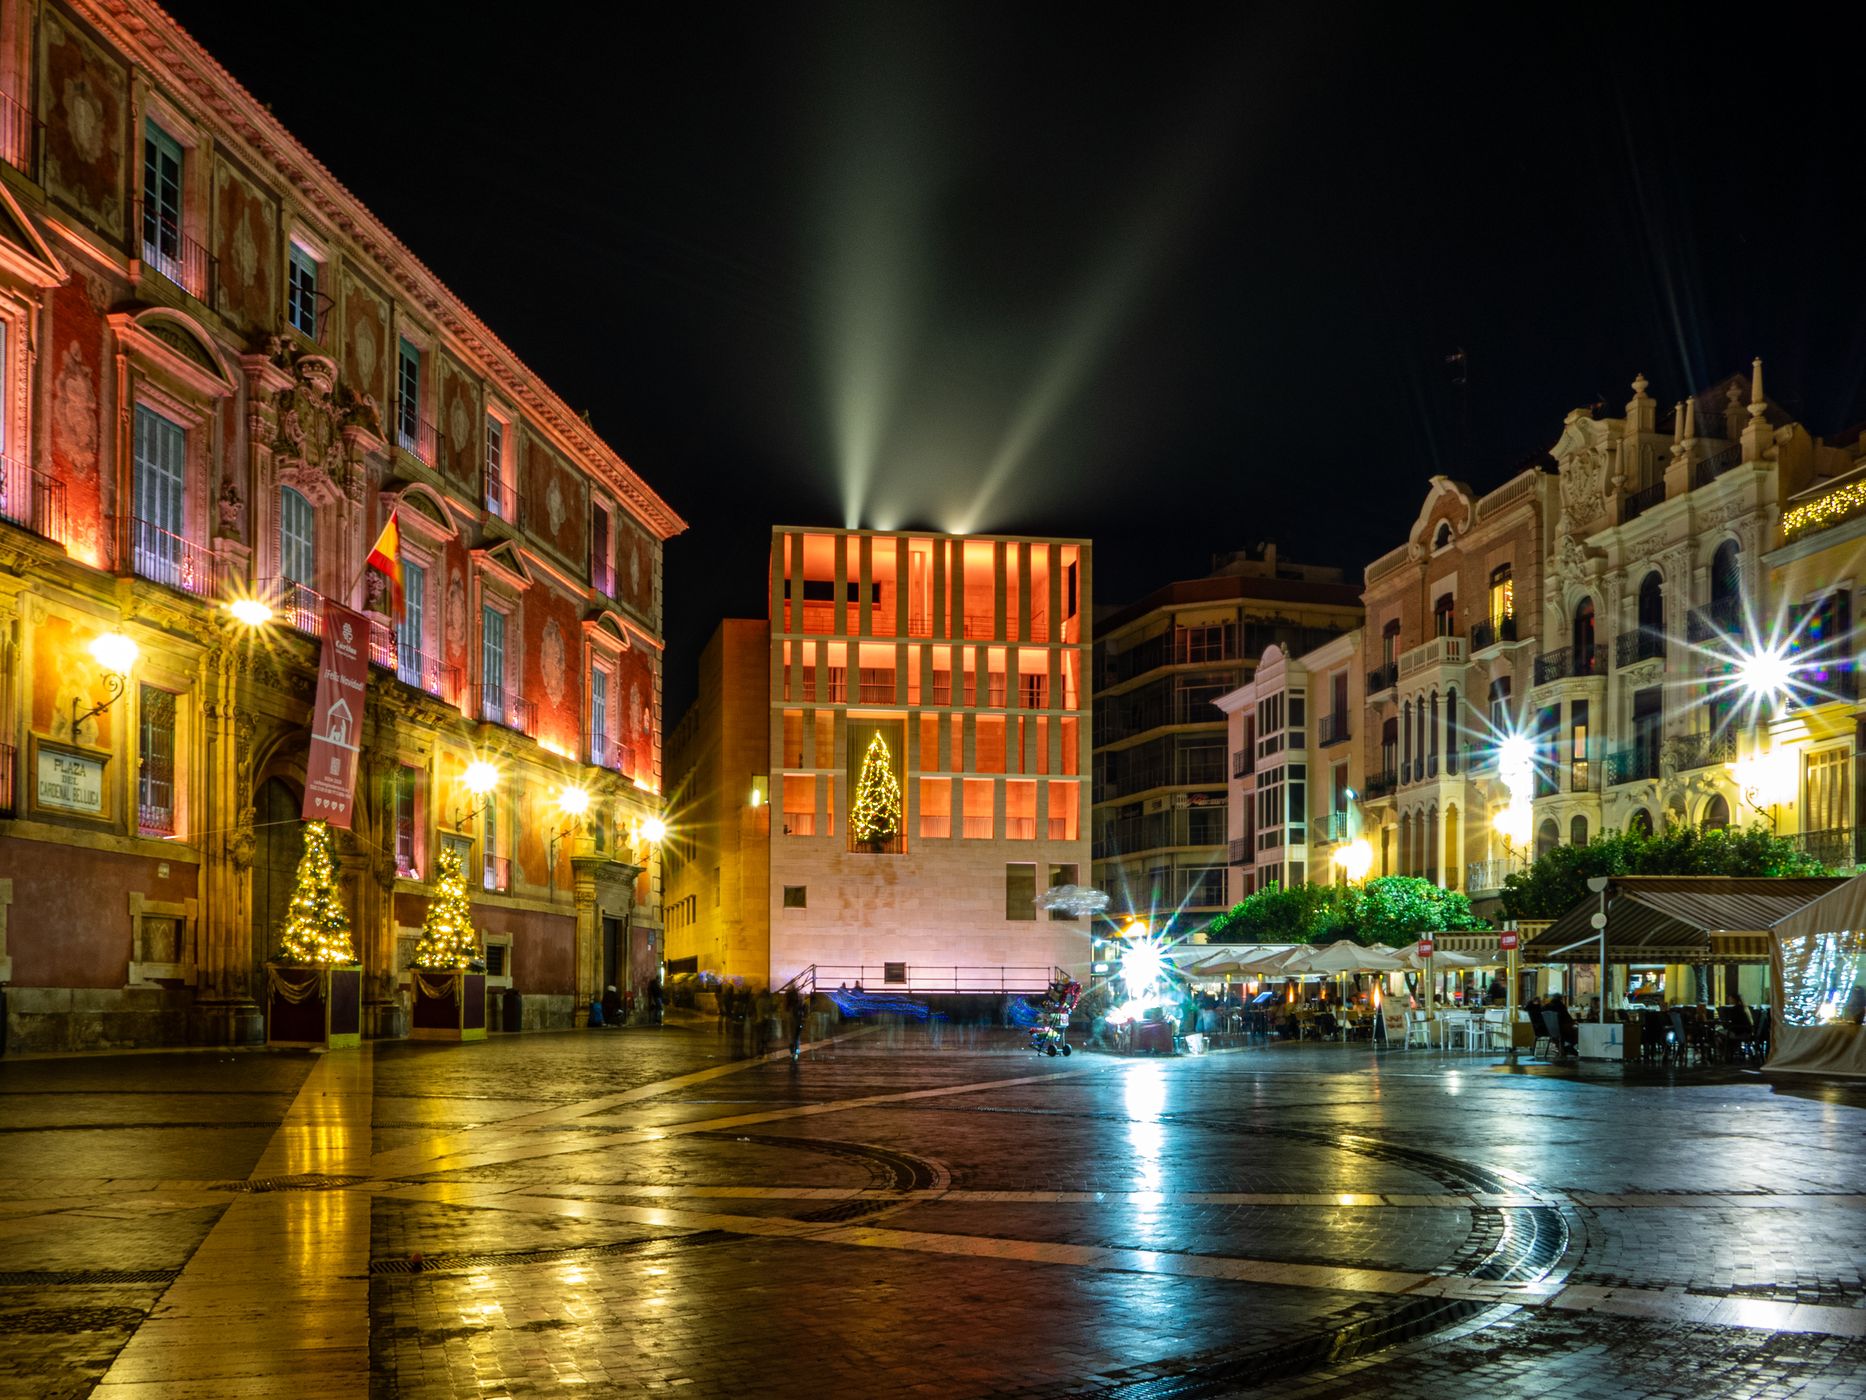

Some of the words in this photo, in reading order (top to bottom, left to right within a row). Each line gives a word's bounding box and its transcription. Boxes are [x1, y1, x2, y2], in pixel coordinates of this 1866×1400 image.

[54, 758, 86, 777] PLAZA
[62, 774, 78, 785] DEL
[40, 780, 70, 801] CARDENAL
[73, 787, 99, 805] BELLUGA
